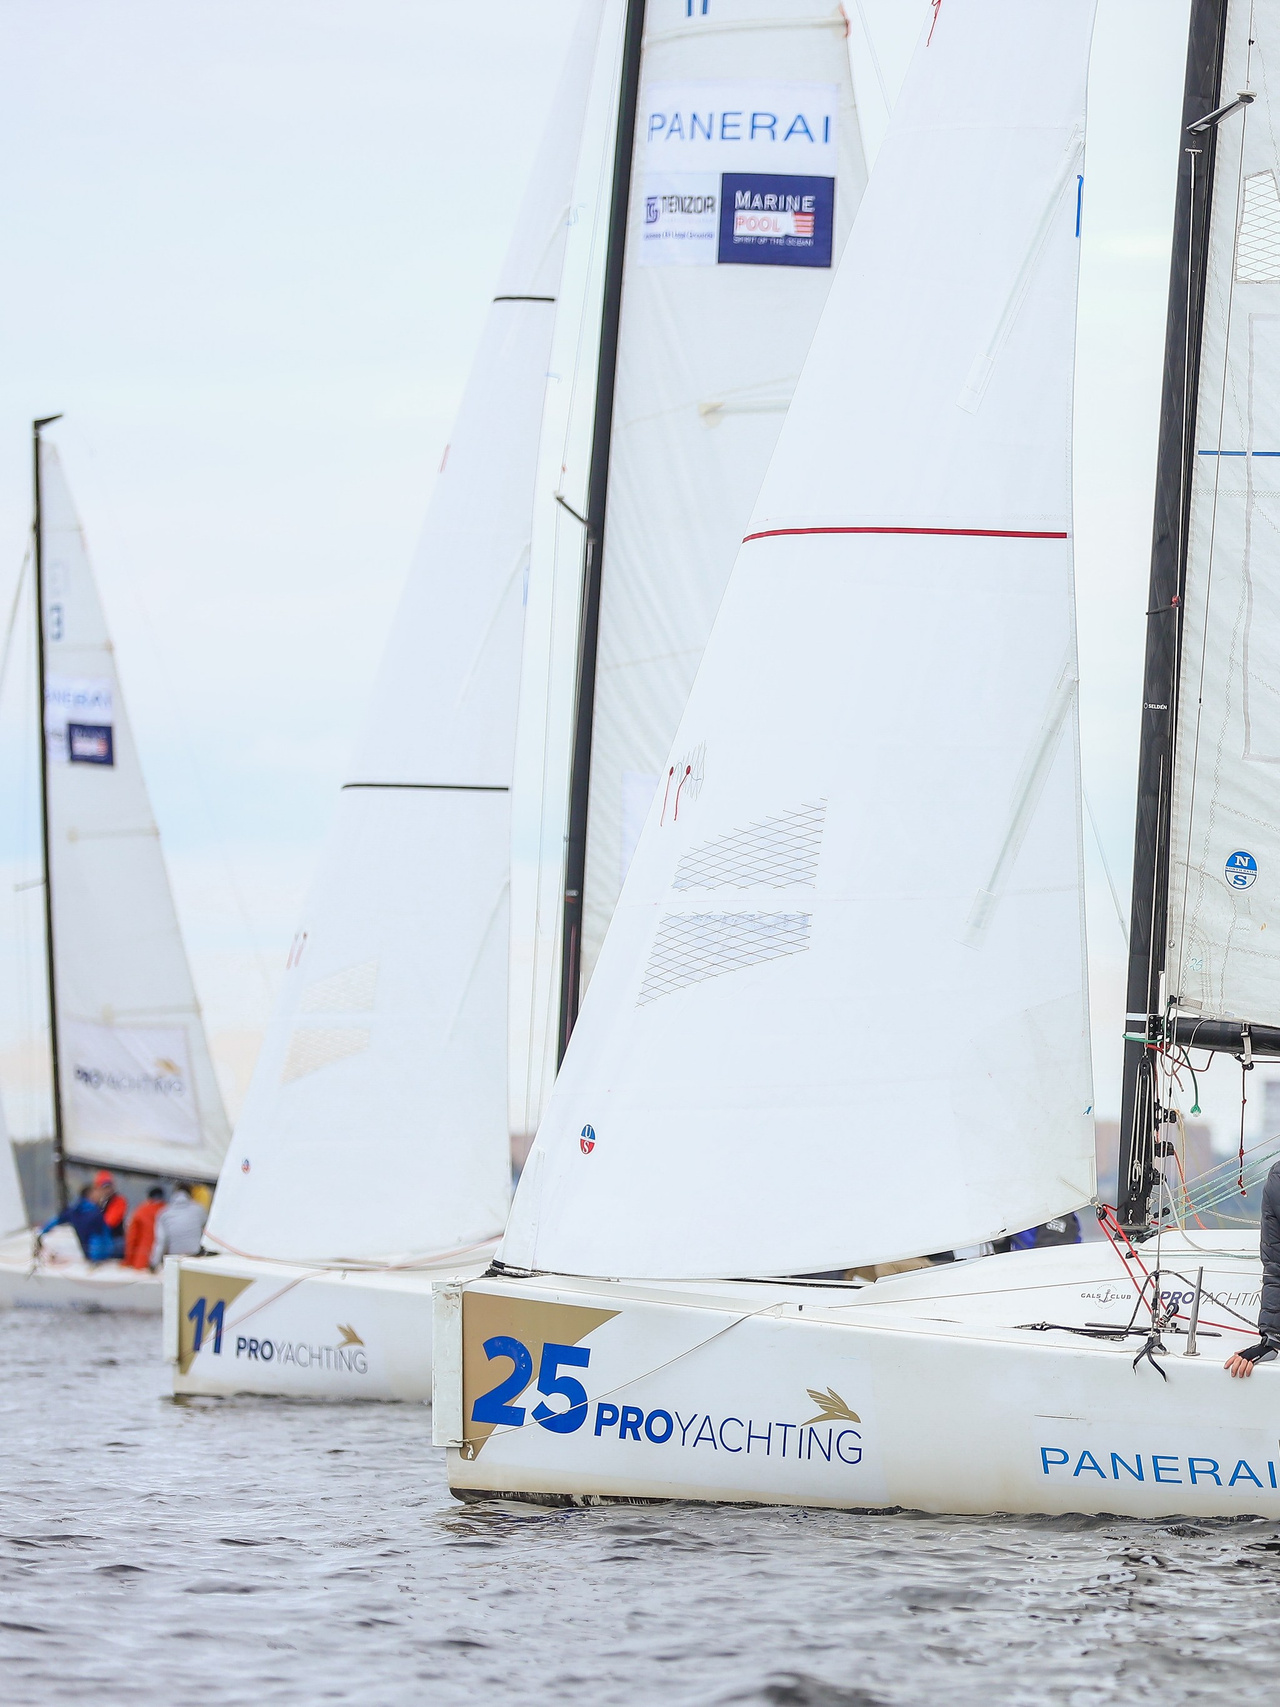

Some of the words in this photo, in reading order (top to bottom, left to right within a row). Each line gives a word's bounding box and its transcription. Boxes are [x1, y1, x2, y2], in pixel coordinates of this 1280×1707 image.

[648, 112, 829, 143] PANERAI
[735, 190, 815, 212] MARINE
[736, 216, 781, 232] POOL
[1234, 855, 1250, 867] N
[1233, 874, 1247, 886] S
[188, 1298, 225, 1354] 11
[236, 1336, 369, 1375] PROYACHTING
[471, 1336, 591, 1434] 25
[594, 1402, 863, 1465] PROYACHTING
[1040, 1446, 1278, 1489] PANERAI
